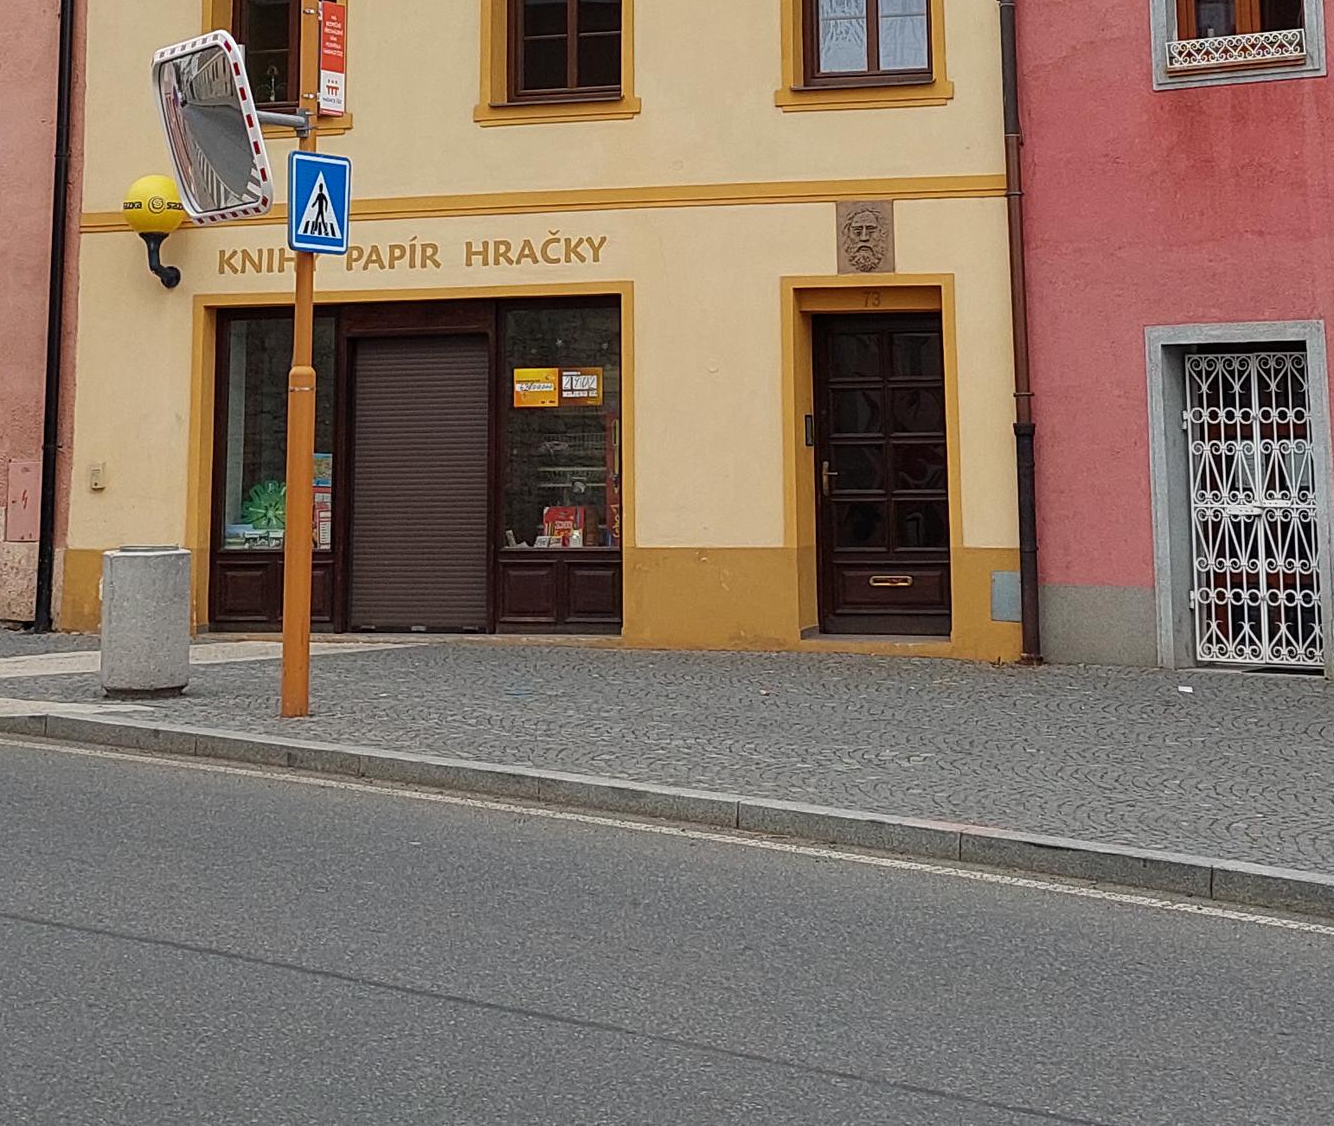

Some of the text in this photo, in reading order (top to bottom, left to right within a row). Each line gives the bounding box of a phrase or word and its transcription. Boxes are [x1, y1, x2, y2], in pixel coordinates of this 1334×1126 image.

[218, 229, 608, 275] KNIH PAPÍR HRAČKY
[861, 290, 882, 308] 73
